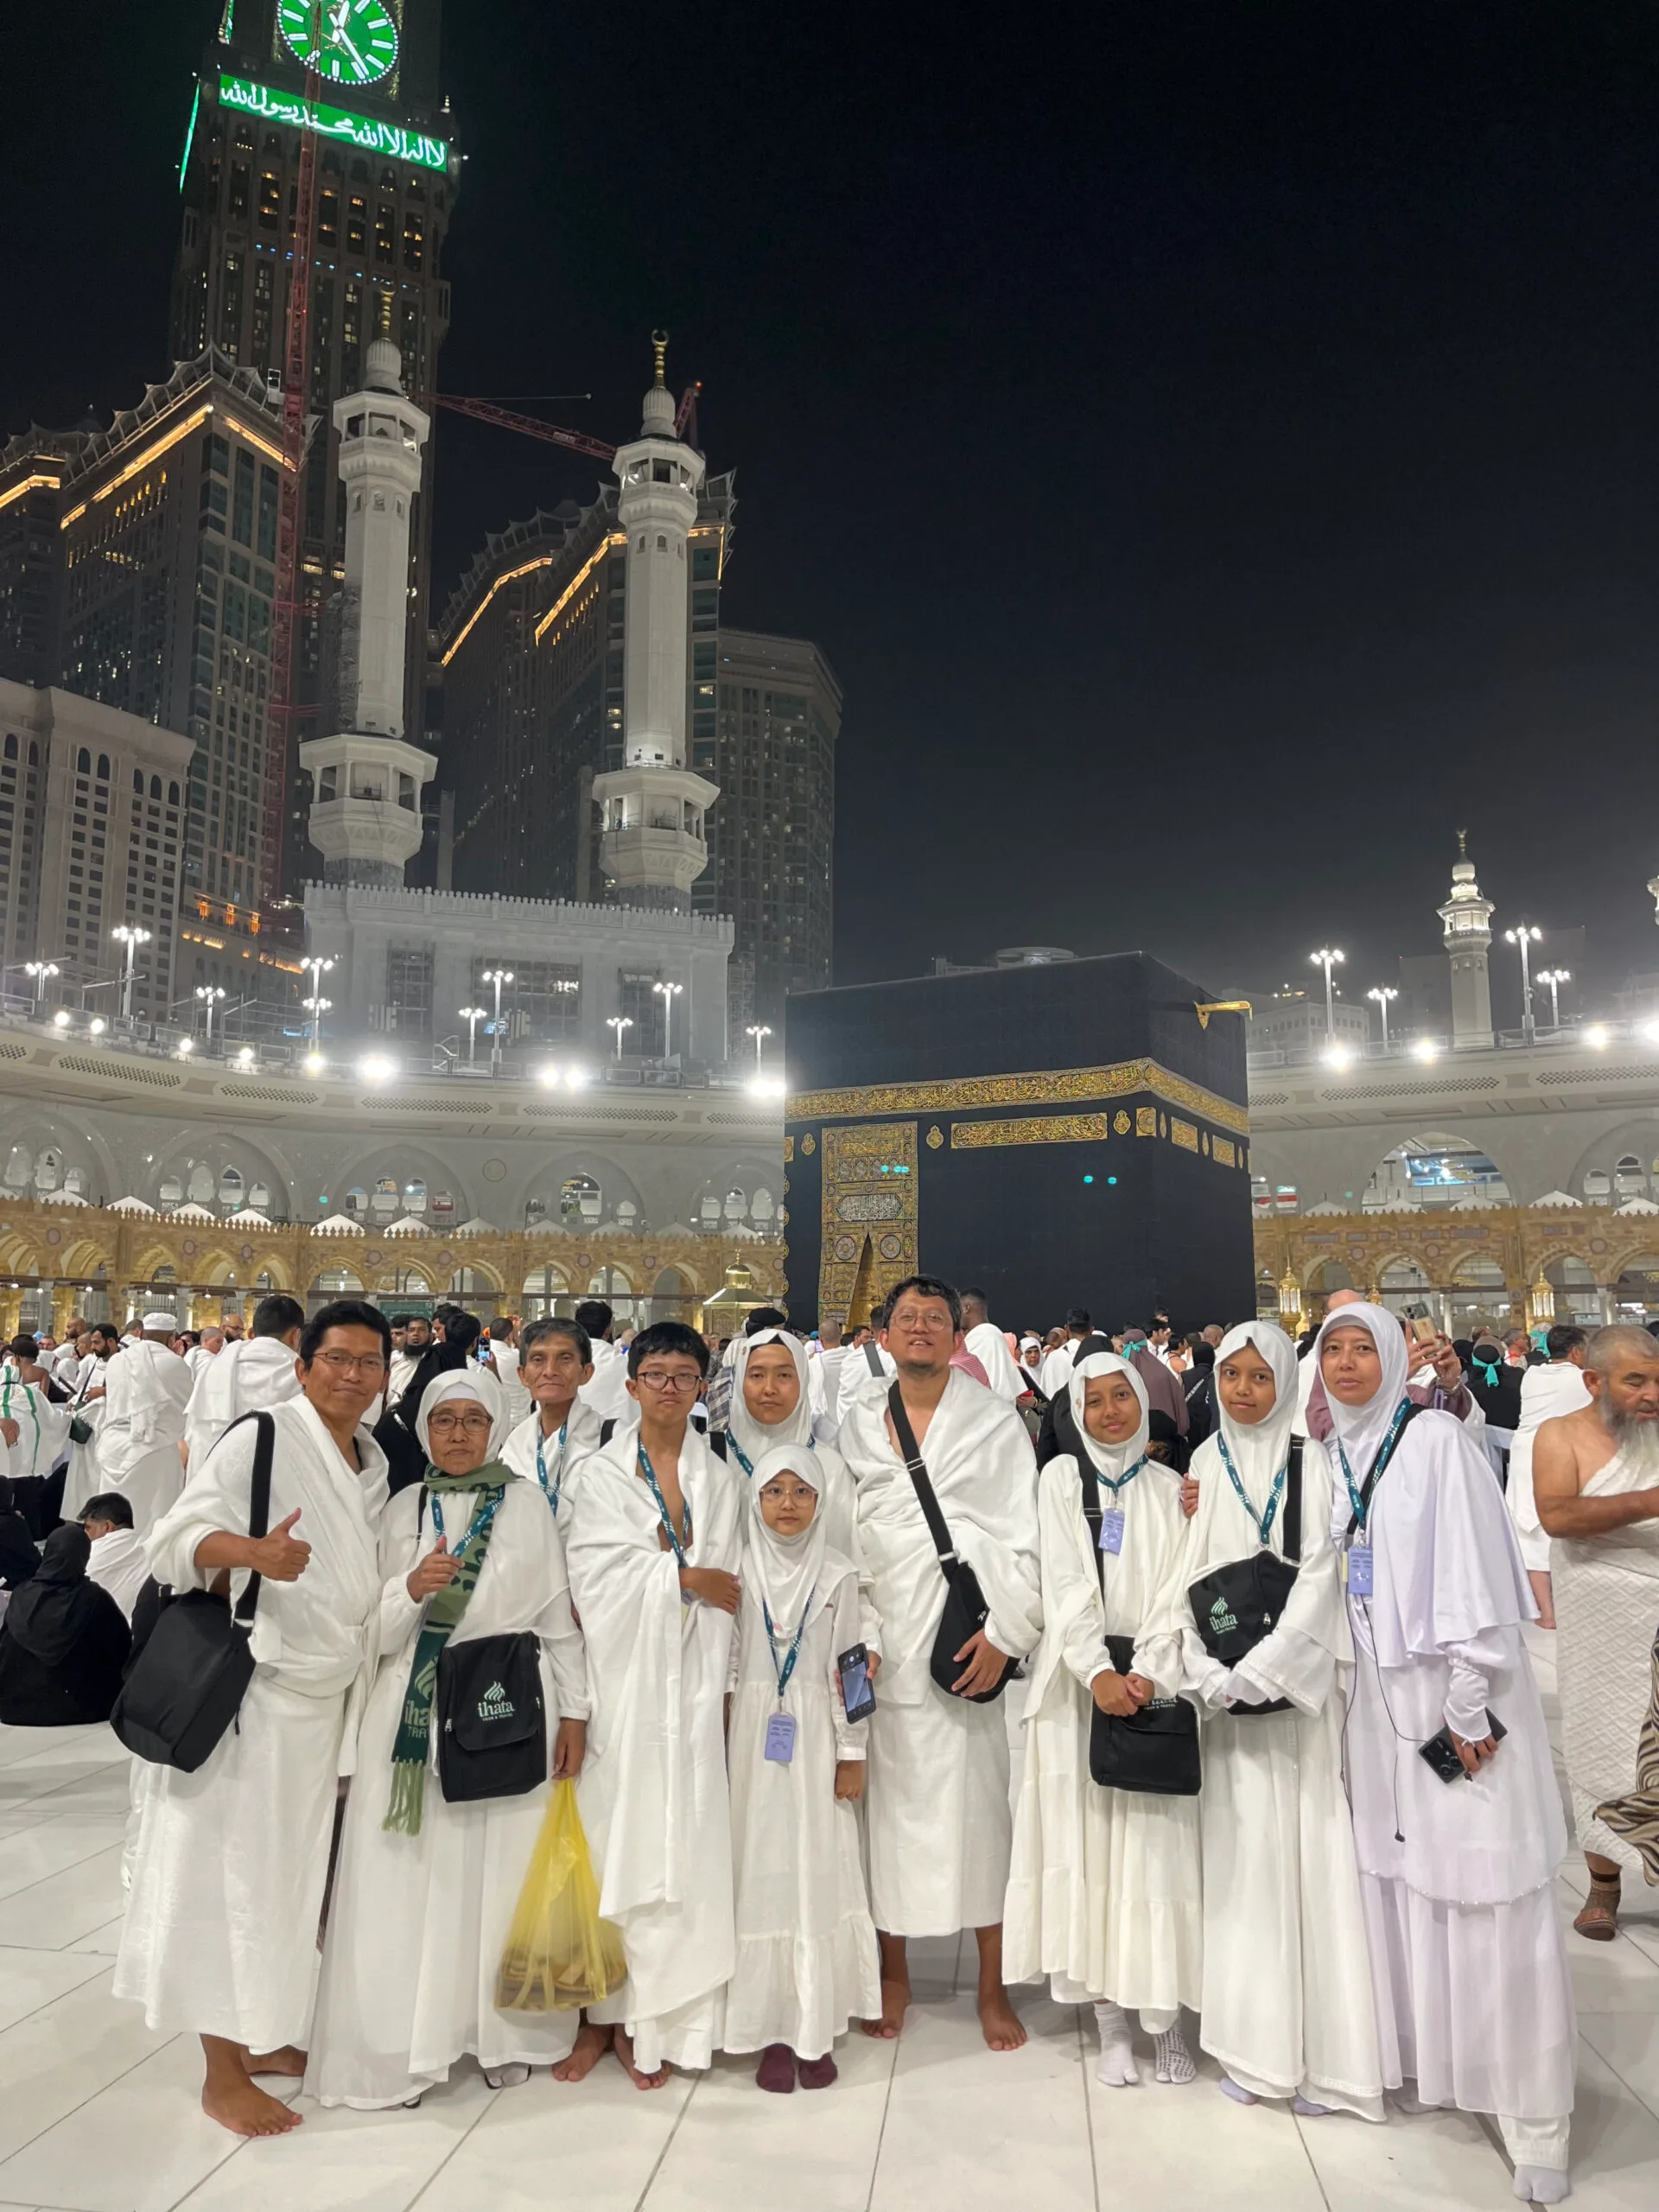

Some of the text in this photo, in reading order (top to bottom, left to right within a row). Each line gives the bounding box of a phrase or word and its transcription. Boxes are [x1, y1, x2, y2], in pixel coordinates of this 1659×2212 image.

[220, 80, 257, 105] الله
[247, 86, 299, 120] رسول
[292, 105, 355, 137] محمد
[353, 121, 384, 148] الله
[1209, 1613, 1238, 1631] ihata
[477, 1700, 516, 1718] ihata
